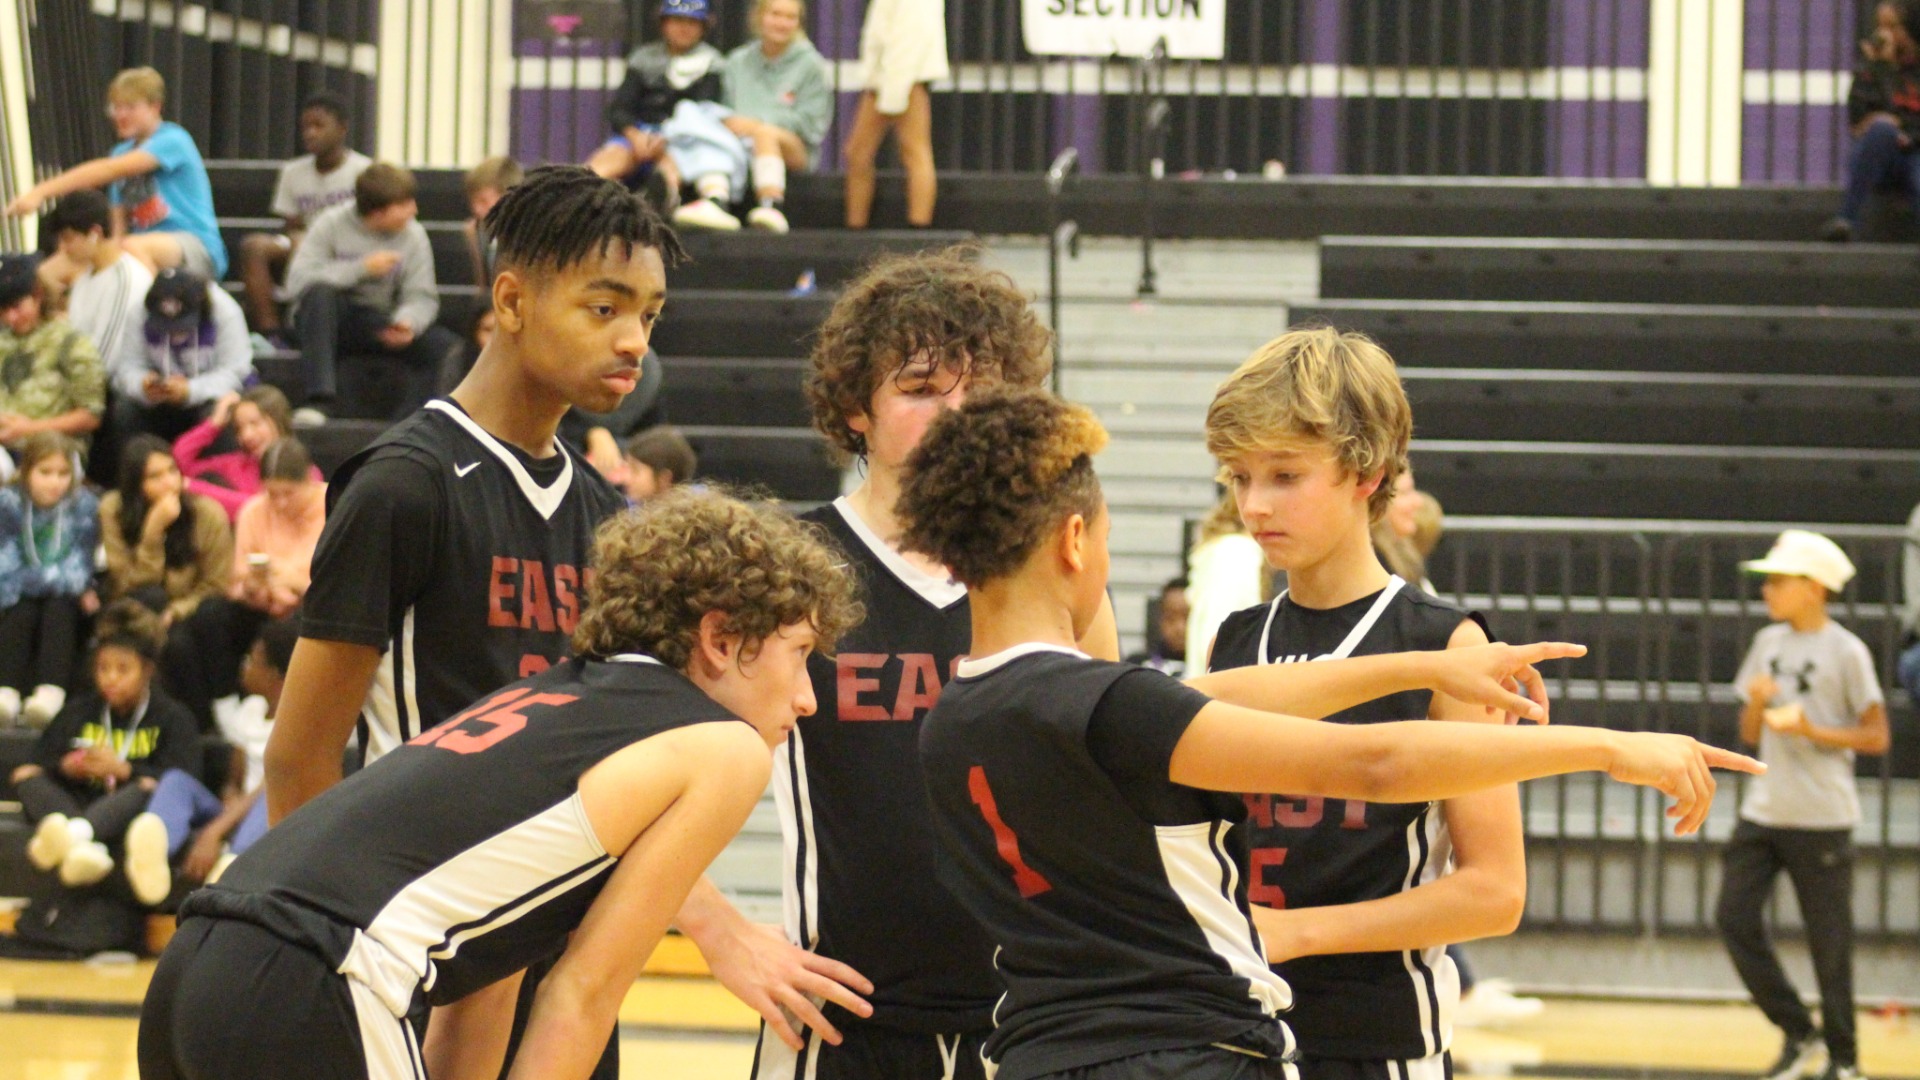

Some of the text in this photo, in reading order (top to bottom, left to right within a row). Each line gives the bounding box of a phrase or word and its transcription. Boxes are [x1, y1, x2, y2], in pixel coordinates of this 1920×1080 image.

[1047, 0, 1201, 19] SECTION
[487, 555, 597, 636] EAS
[406, 687, 581, 755] 15
[836, 653, 968, 722] EA
[968, 765, 1053, 899] 1
[1247, 847, 1288, 910] 5
